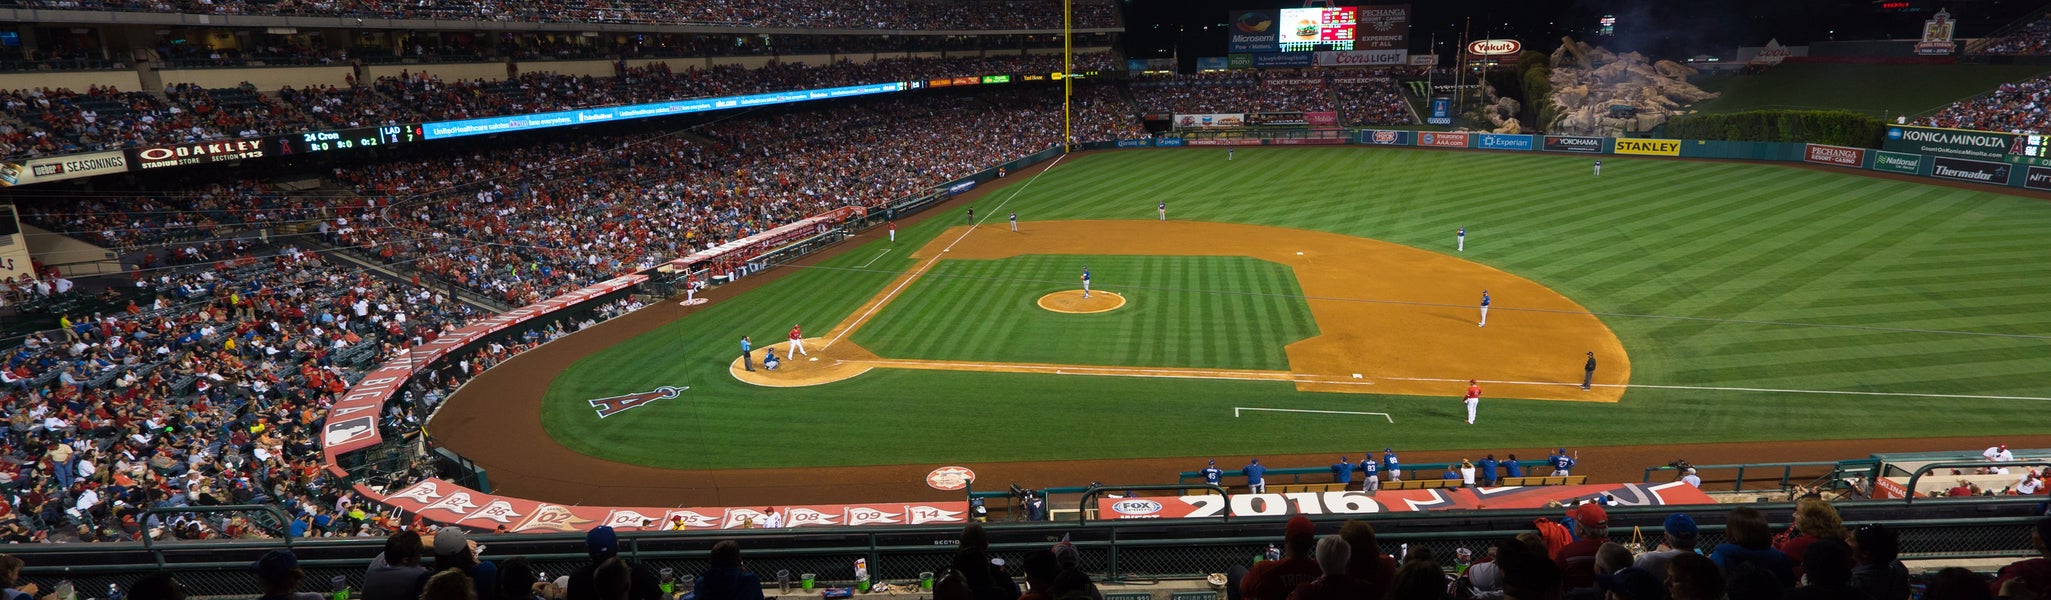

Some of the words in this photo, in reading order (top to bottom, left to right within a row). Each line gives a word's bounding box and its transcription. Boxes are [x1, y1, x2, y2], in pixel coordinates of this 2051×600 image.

[1362, 9, 1406, 17] PECHANGA
[1927, 23, 1951, 41] 50
[1232, 34, 1275, 43] Microsemi
[1478, 43, 1512, 51] Yakult
[1336, 52, 1370, 64] Coors
[1371, 54, 1401, 63] LIGHT
[385, 126, 401, 135] LAD
[406, 125, 412, 133] 1
[416, 128, 423, 136] 6
[304, 133, 317, 142] 24
[318, 131, 340, 141] Cron
[407, 133, 413, 142] 7
[1902, 130, 1949, 147] KONICA
[1949, 134, 2006, 149] MINOLTA
[1117, 140, 1138, 148] Corona
[1496, 138, 1529, 149] Experian
[1559, 138, 1598, 147] YOKOHAMA
[1616, 140, 1679, 154] STANLEY
[176, 140, 262, 157] OAKLEY
[1811, 147, 1857, 159] PECHANGA
[1920, 145, 2003, 159] CountOnKonicaMinolta.com
[211, 153, 239, 162] SECTION
[239, 150, 264, 159] 113
[1811, 154, 1832, 162] RESORT
[1835, 157, 1856, 165] CASINO
[1886, 156, 1918, 167] National
[66, 156, 124, 173] SEASONINGS
[141, 158, 179, 169] STADIUM
[179, 157, 201, 165] STORE
[1935, 165, 1994, 181] Thermador
[378, 347, 442, 373] THE
[343, 376, 399, 402] BIG
[333, 404, 376, 418] A
[1208, 472, 1216, 480] 45
[1877, 478, 1907, 498] SALINAS
[1178, 490, 1380, 518] 2016
[615, 514, 642, 524] '04
[733, 513, 759, 522] '07
[794, 512, 820, 522] '08
[854, 511, 882, 521] '09
[914, 510, 940, 519] '14
